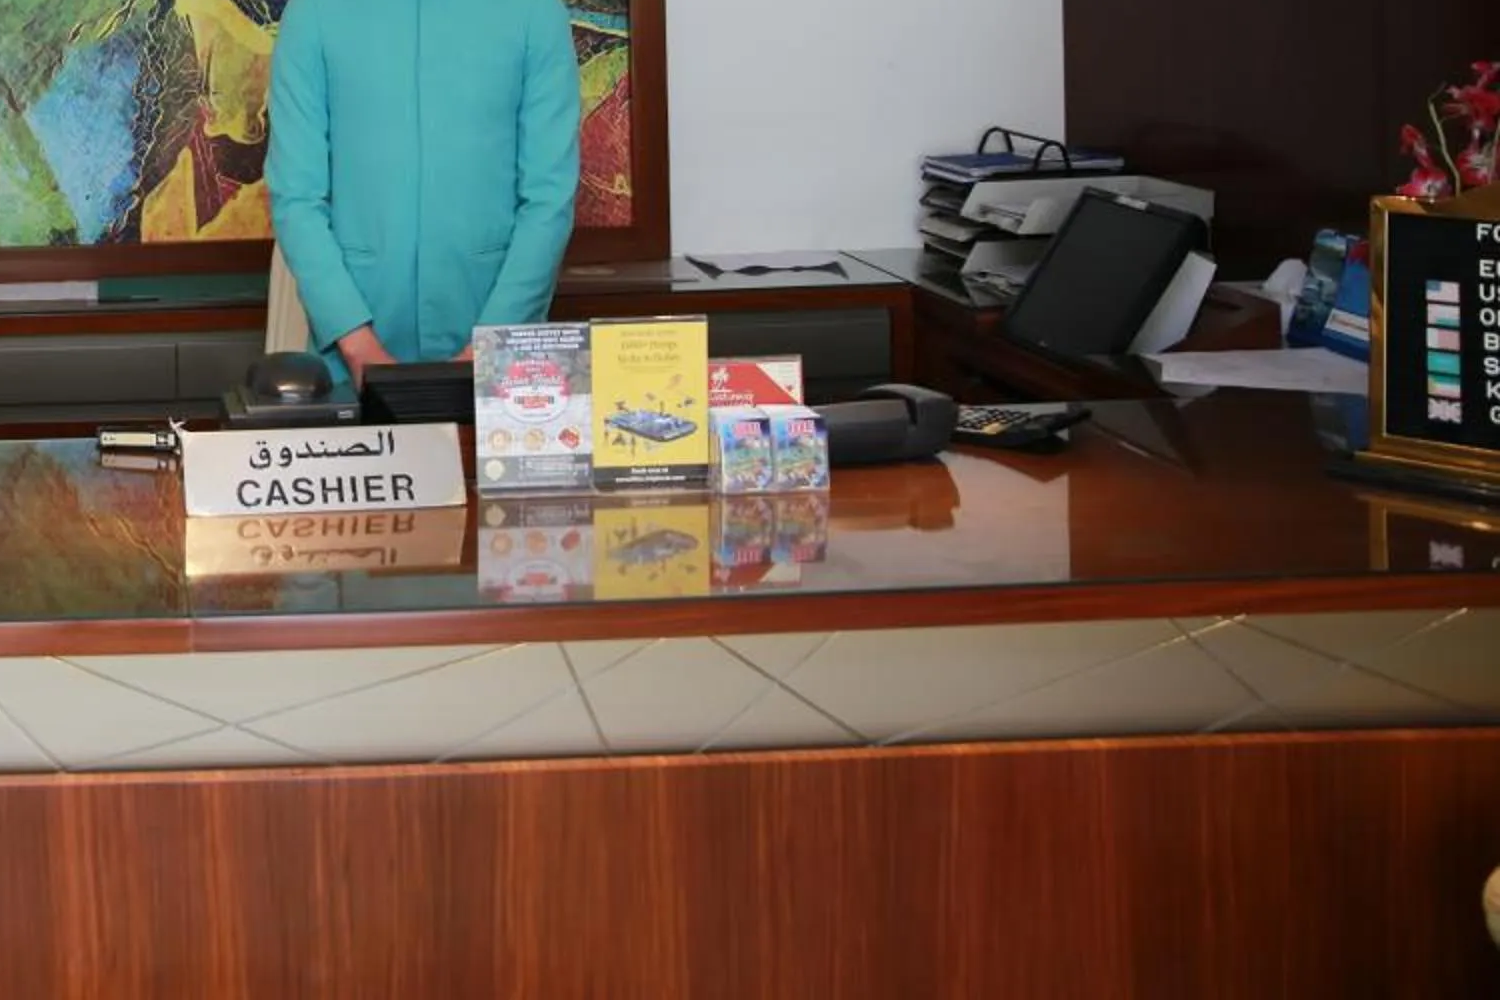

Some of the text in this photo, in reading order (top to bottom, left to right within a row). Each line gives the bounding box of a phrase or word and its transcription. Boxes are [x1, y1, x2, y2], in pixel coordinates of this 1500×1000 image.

[1480, 307, 1500, 328] O
[249, 428, 395, 469] الصندوق
[236, 473, 415, 508] CASHIER
